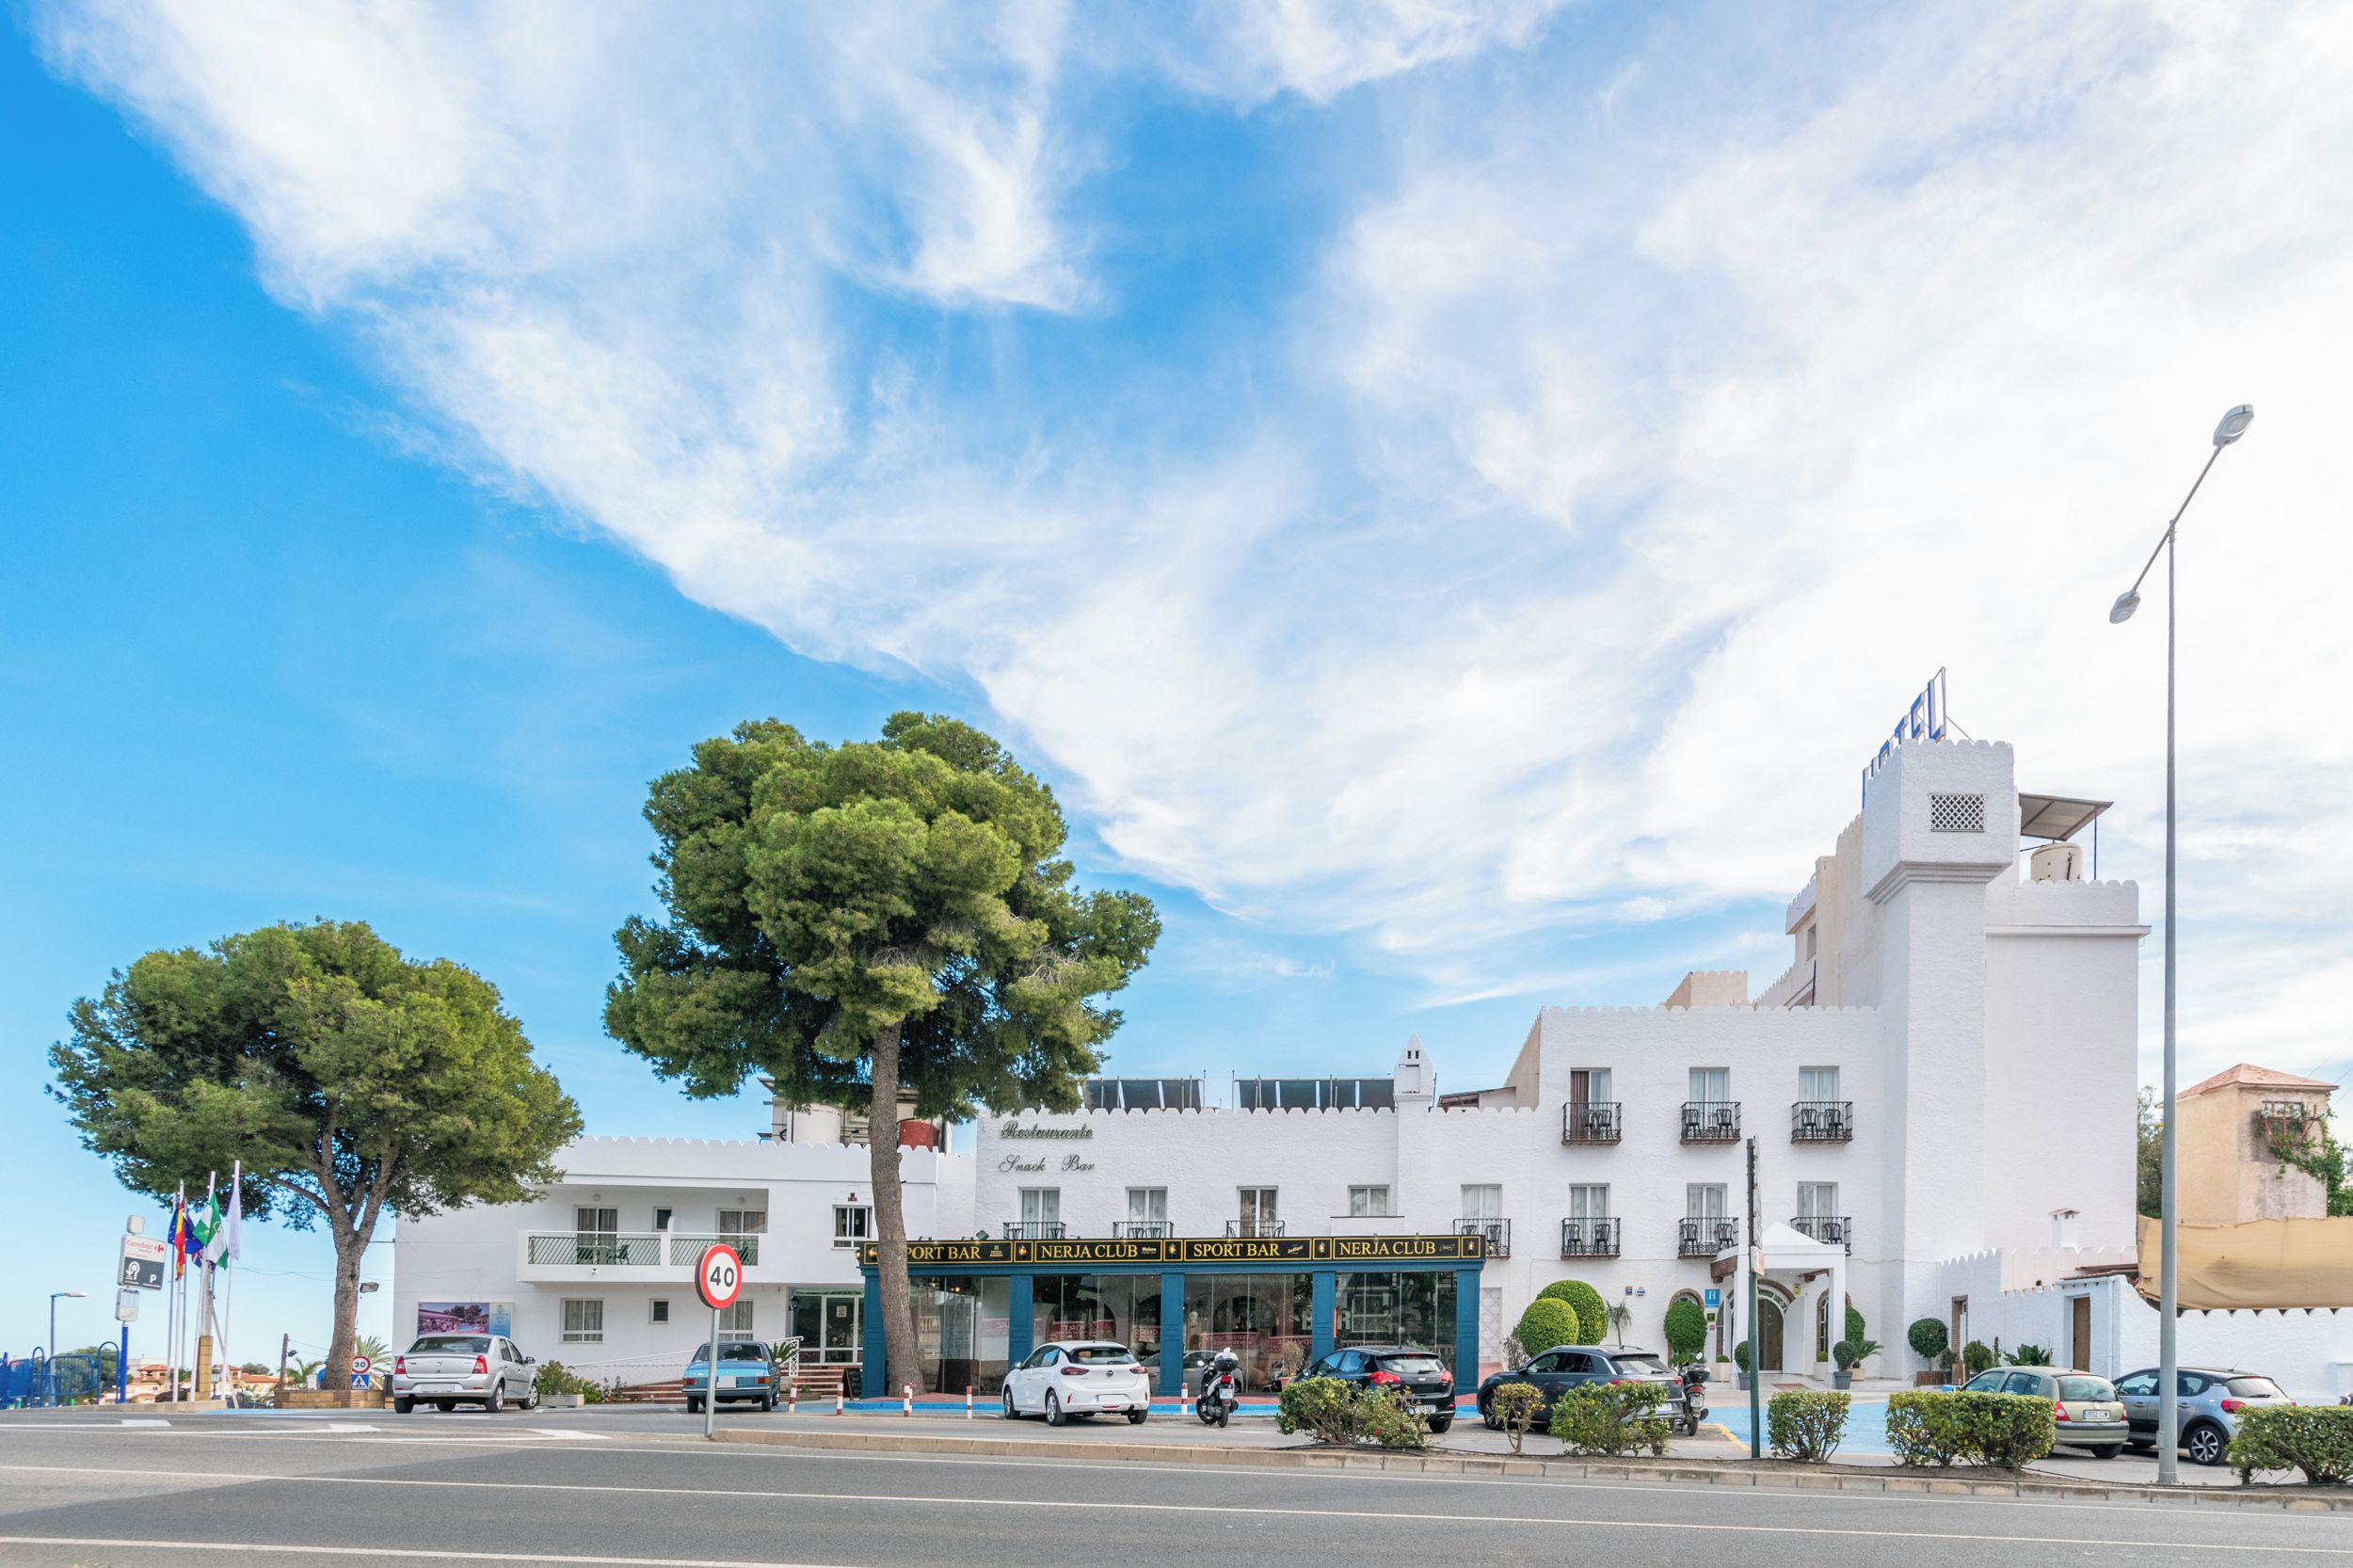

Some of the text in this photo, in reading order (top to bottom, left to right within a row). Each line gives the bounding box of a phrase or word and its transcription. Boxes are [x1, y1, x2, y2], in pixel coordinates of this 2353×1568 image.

[1000, 1120, 1093, 1140] Restaurante
[999, 1154, 1095, 1173] Snack Bar
[906, 1246, 944, 1259] PORT
[948, 1246, 982, 1259] BAR
[1041, 1245, 1092, 1258] NERJA
[1095, 1244, 1138, 1258] CLUB
[1193, 1242, 1243, 1256] SPORT
[1246, 1242, 1280, 1256] BAR
[1339, 1241, 1390, 1255] NERJA
[1392, 1240, 1435, 1255] CLUB
[150, 1273, 157, 1283] P
[710, 1266, 734, 1287] 40
[1708, 1290, 1716, 1300] H
